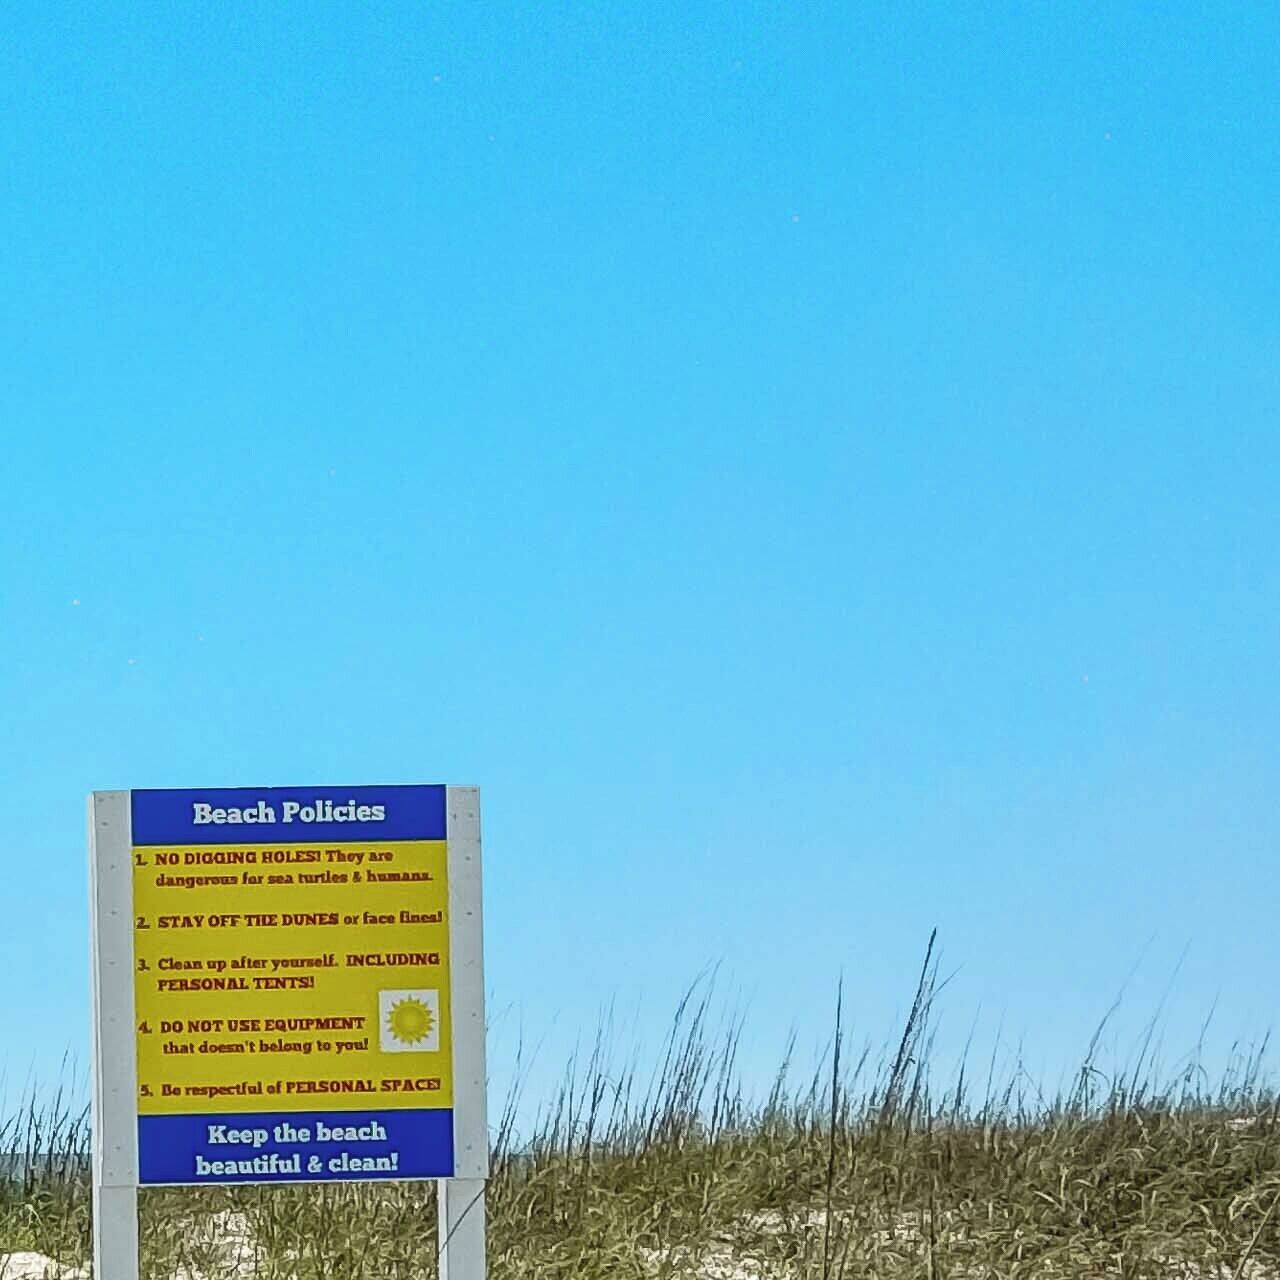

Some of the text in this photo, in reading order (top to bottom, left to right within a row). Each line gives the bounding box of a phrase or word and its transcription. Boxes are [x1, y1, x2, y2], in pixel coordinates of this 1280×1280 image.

[193, 799, 385, 824] Beach Policies
[135, 850, 393, 866] 1. NO DIGGING HOLES! They are
[155, 870, 433, 889] dangerous for sea turtles & humans.
[136, 910, 442, 930] 2. STAY OFF THE DUNES or face fines!
[137, 953, 440, 973] 3. Clean up after yourself. INCLUDING
[158, 976, 315, 991] PERSONAL TENTS!
[139, 1017, 366, 1033] 4. DO NOT USE EQUIPMENT
[163, 1038, 368, 1055] that doesn't belong to you!
[140, 1078, 441, 1099] 5. Be respectful of PERSONAL SPACE!
[208, 1121, 387, 1148] Keep the beach
[196, 1152, 399, 1175] beautiful & clean!
